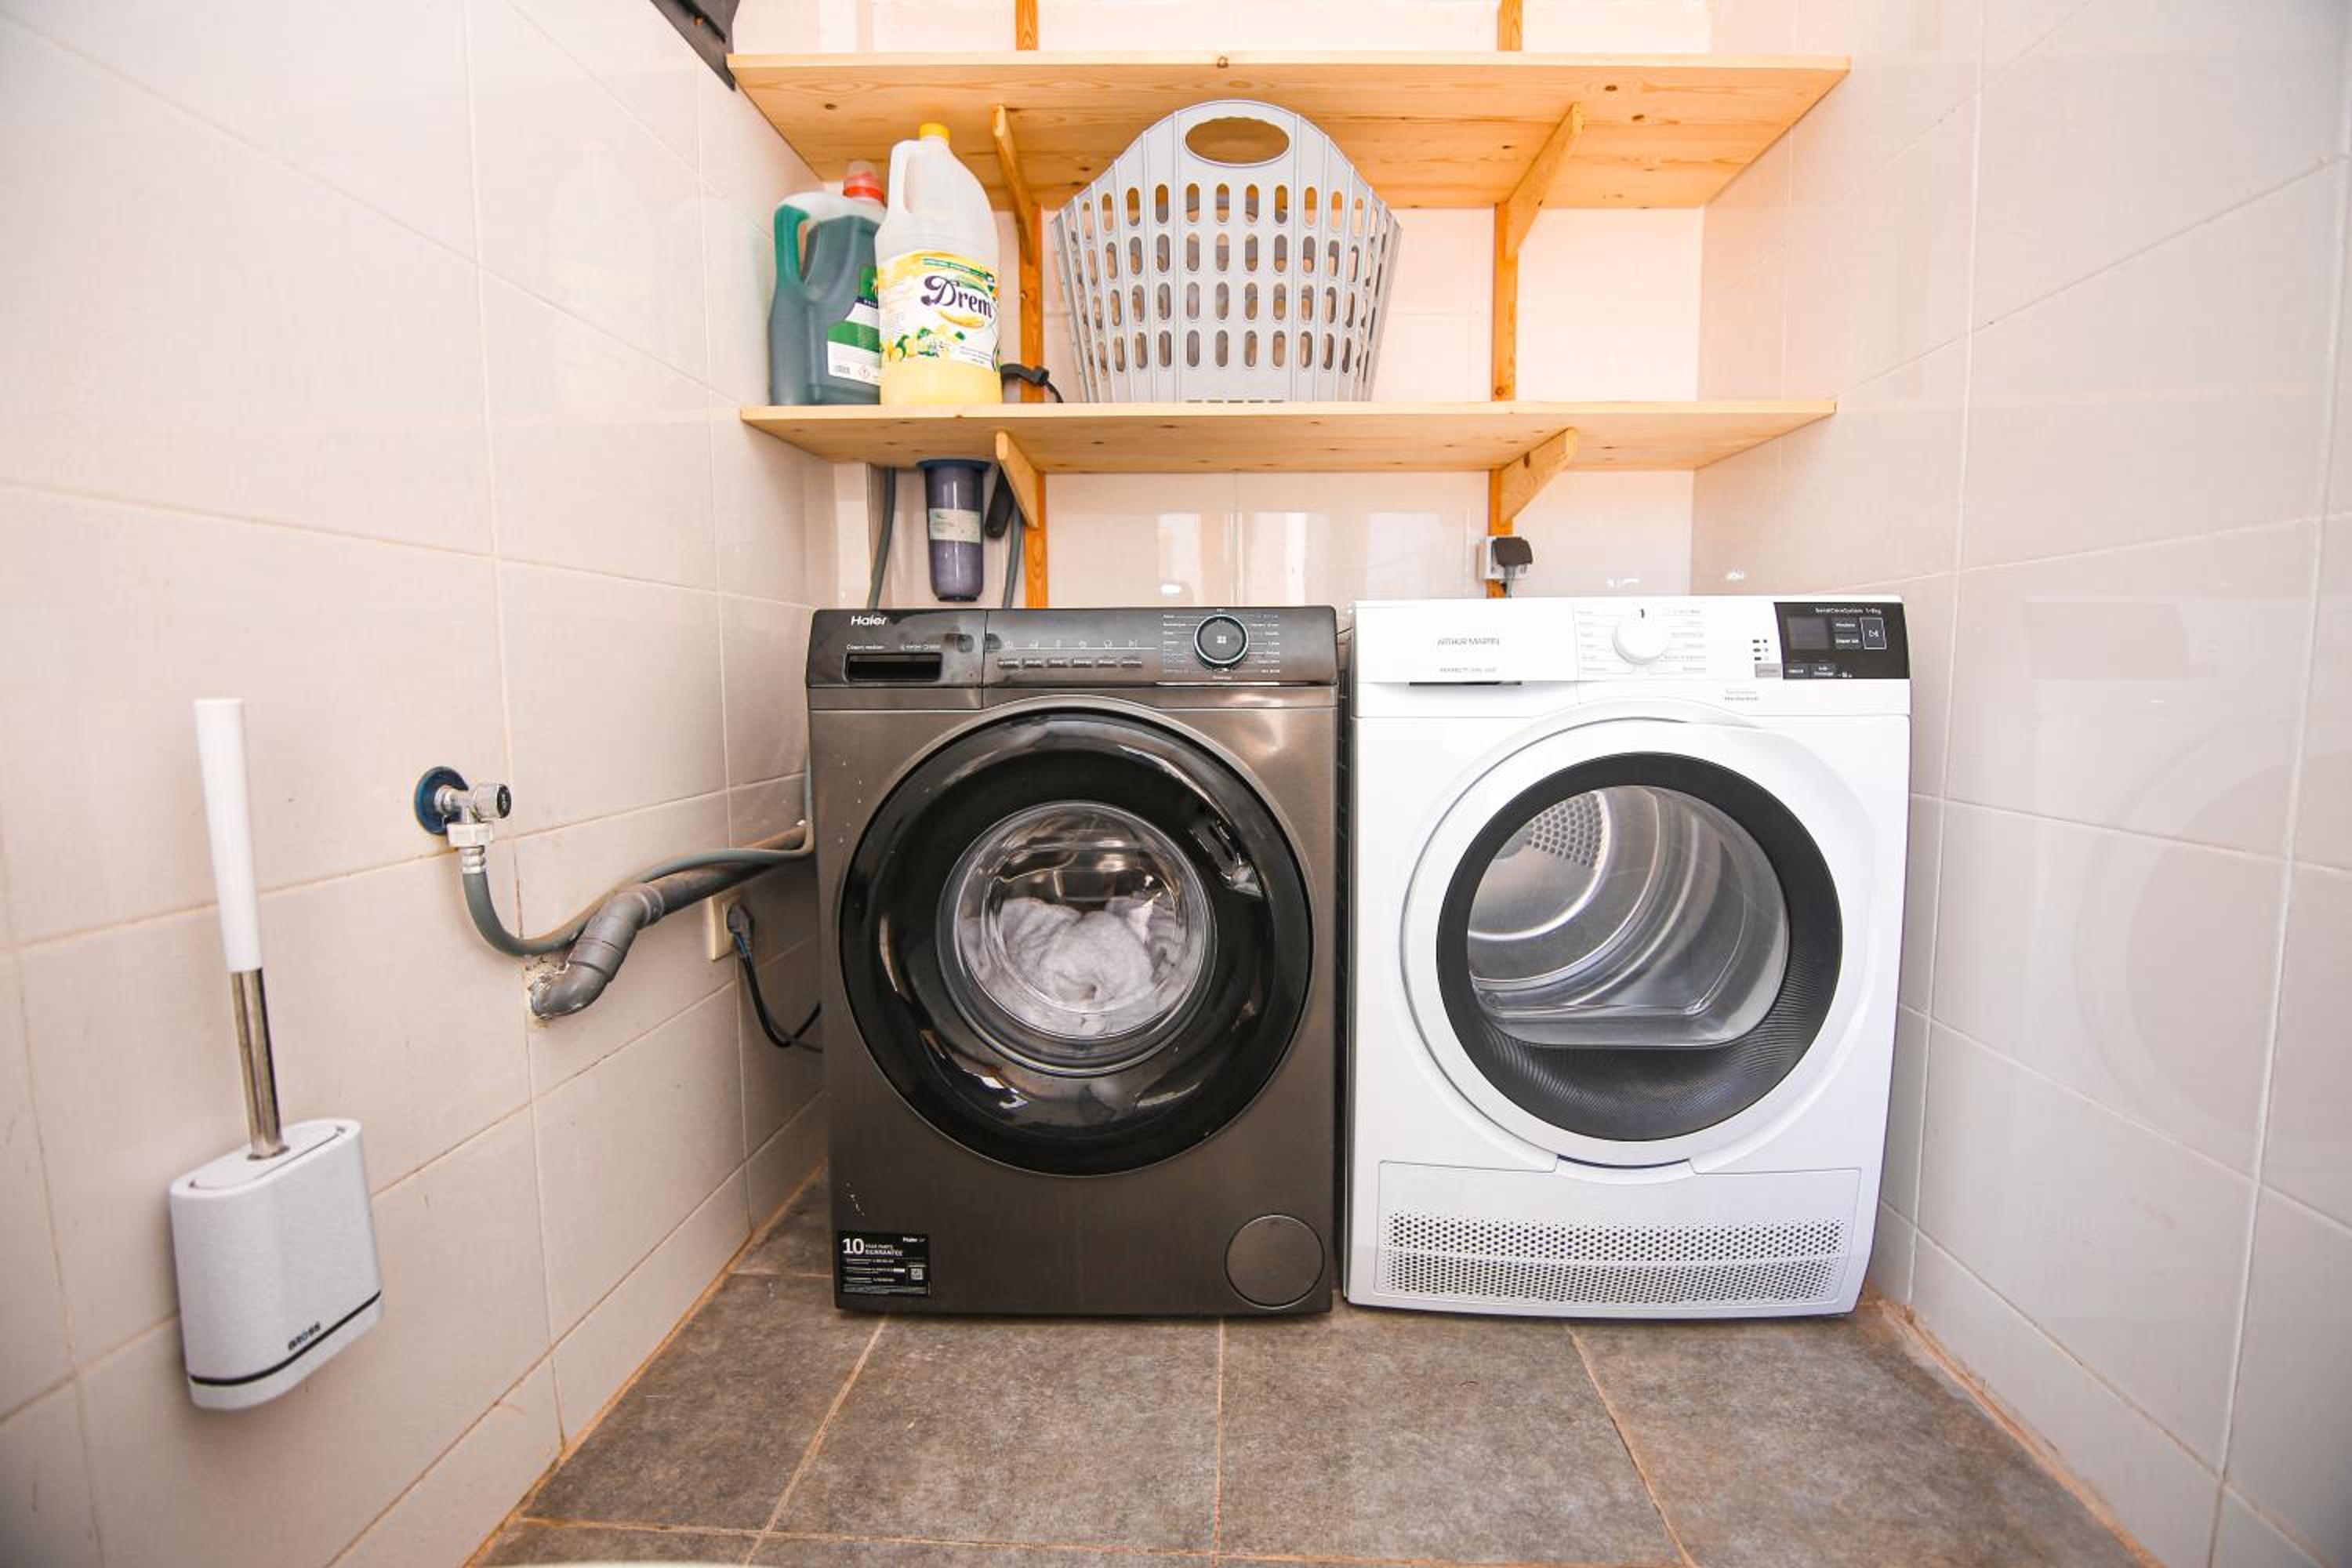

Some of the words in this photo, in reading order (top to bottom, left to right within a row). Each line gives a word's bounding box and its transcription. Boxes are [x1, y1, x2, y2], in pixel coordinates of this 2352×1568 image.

[920, 275, 992, 318] Drem
[851, 615, 887, 626] Haier
[842, 1238, 865, 1255] 10
